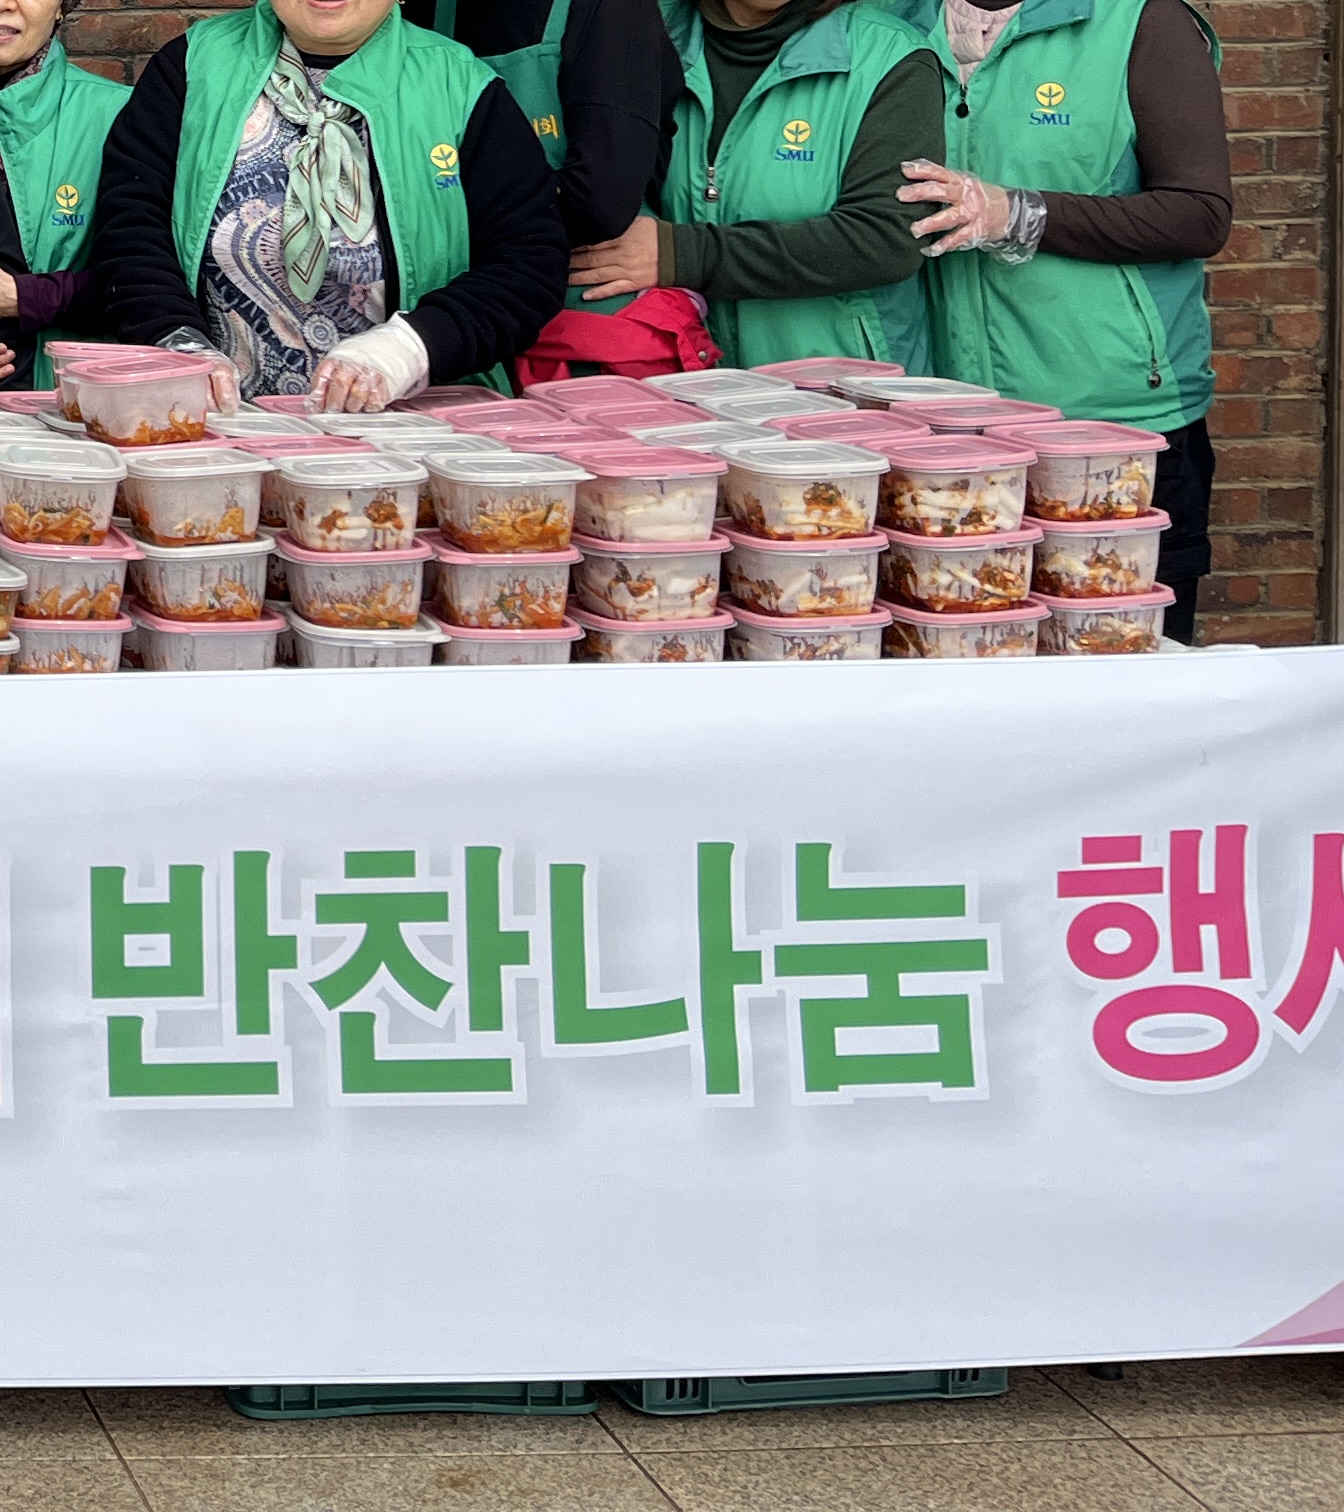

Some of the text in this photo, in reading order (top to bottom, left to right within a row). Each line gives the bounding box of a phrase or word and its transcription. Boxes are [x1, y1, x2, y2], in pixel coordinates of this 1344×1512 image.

[1029, 111, 1071, 126] SMU
[774, 148, 815, 162] SMU
[434, 174, 460, 190] SM
[51, 213, 85, 226] SMU
[92, 842, 988, 1095] 반찬나눔
